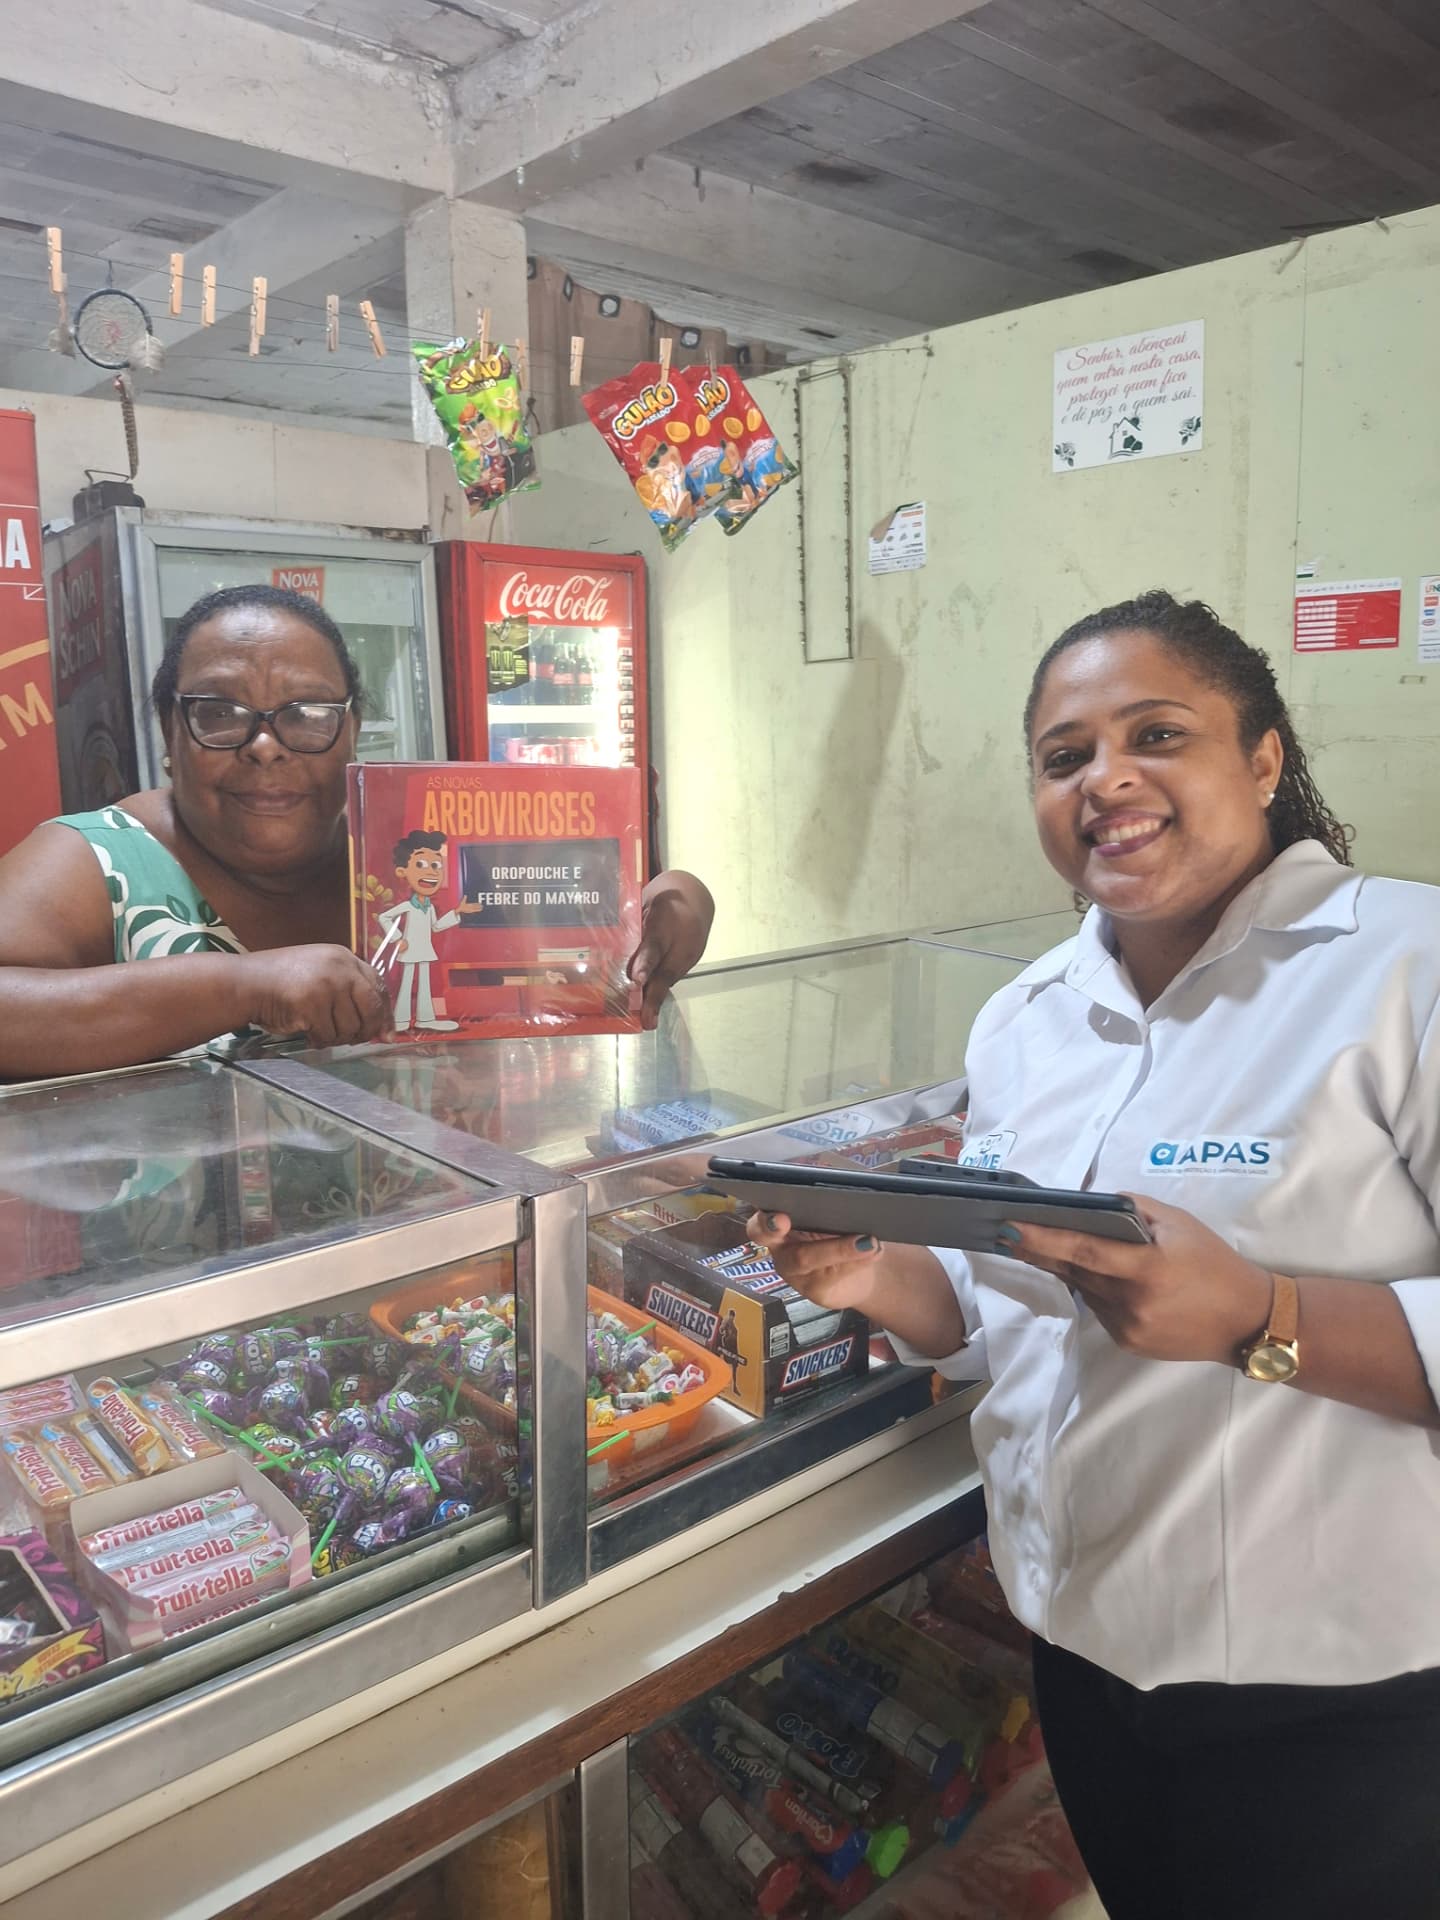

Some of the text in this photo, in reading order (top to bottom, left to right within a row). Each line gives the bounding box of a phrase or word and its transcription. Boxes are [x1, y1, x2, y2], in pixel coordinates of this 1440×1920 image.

[1056, 376, 1088, 395] quem
[1093, 364, 1124, 382] entra
[1129, 354, 1163, 374] nesta
[1066, 368, 1187, 412] protegei quem fica
[1087, 405, 1113, 425] paz
[1132, 394, 1166, 416] quem
[59, 568, 98, 626] NOVA
[279, 571, 319, 589] NOVA
[500, 571, 614, 621] Coca-Cola
[423, 790, 596, 836] ARBOVIROSES
[491, 866, 582, 880] OROPOUCHE E
[478, 892, 524, 906] FEBRE
[527, 892, 542, 906] DO
[648, 1287, 716, 1341] SNICKERS
[785, 1339, 851, 1385] SNICKERS
